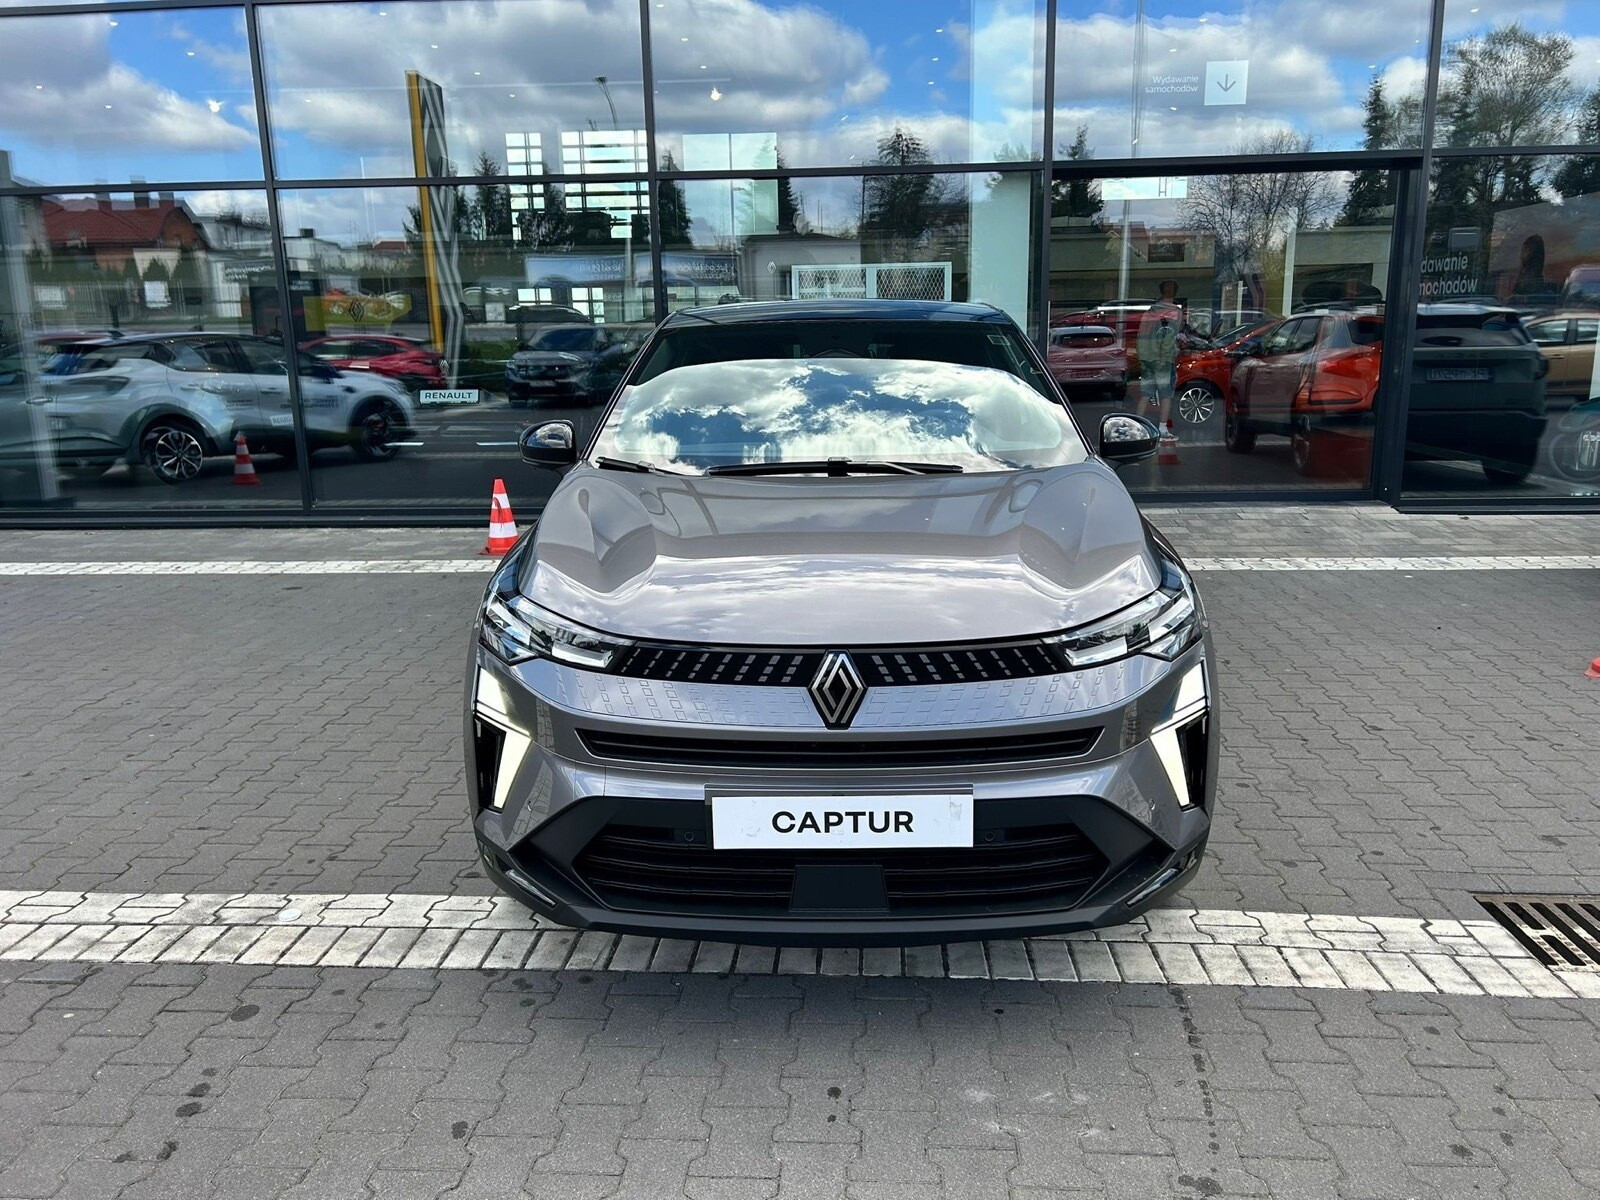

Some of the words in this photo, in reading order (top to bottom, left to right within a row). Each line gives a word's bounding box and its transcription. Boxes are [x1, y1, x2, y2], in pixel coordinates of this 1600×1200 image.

[1152, 75, 1199, 85] Wydawanie
[1144, 84, 1199, 94] samochodów
[1420, 252, 1469, 273] dawanie
[771, 810, 914, 833] CAPTUR
